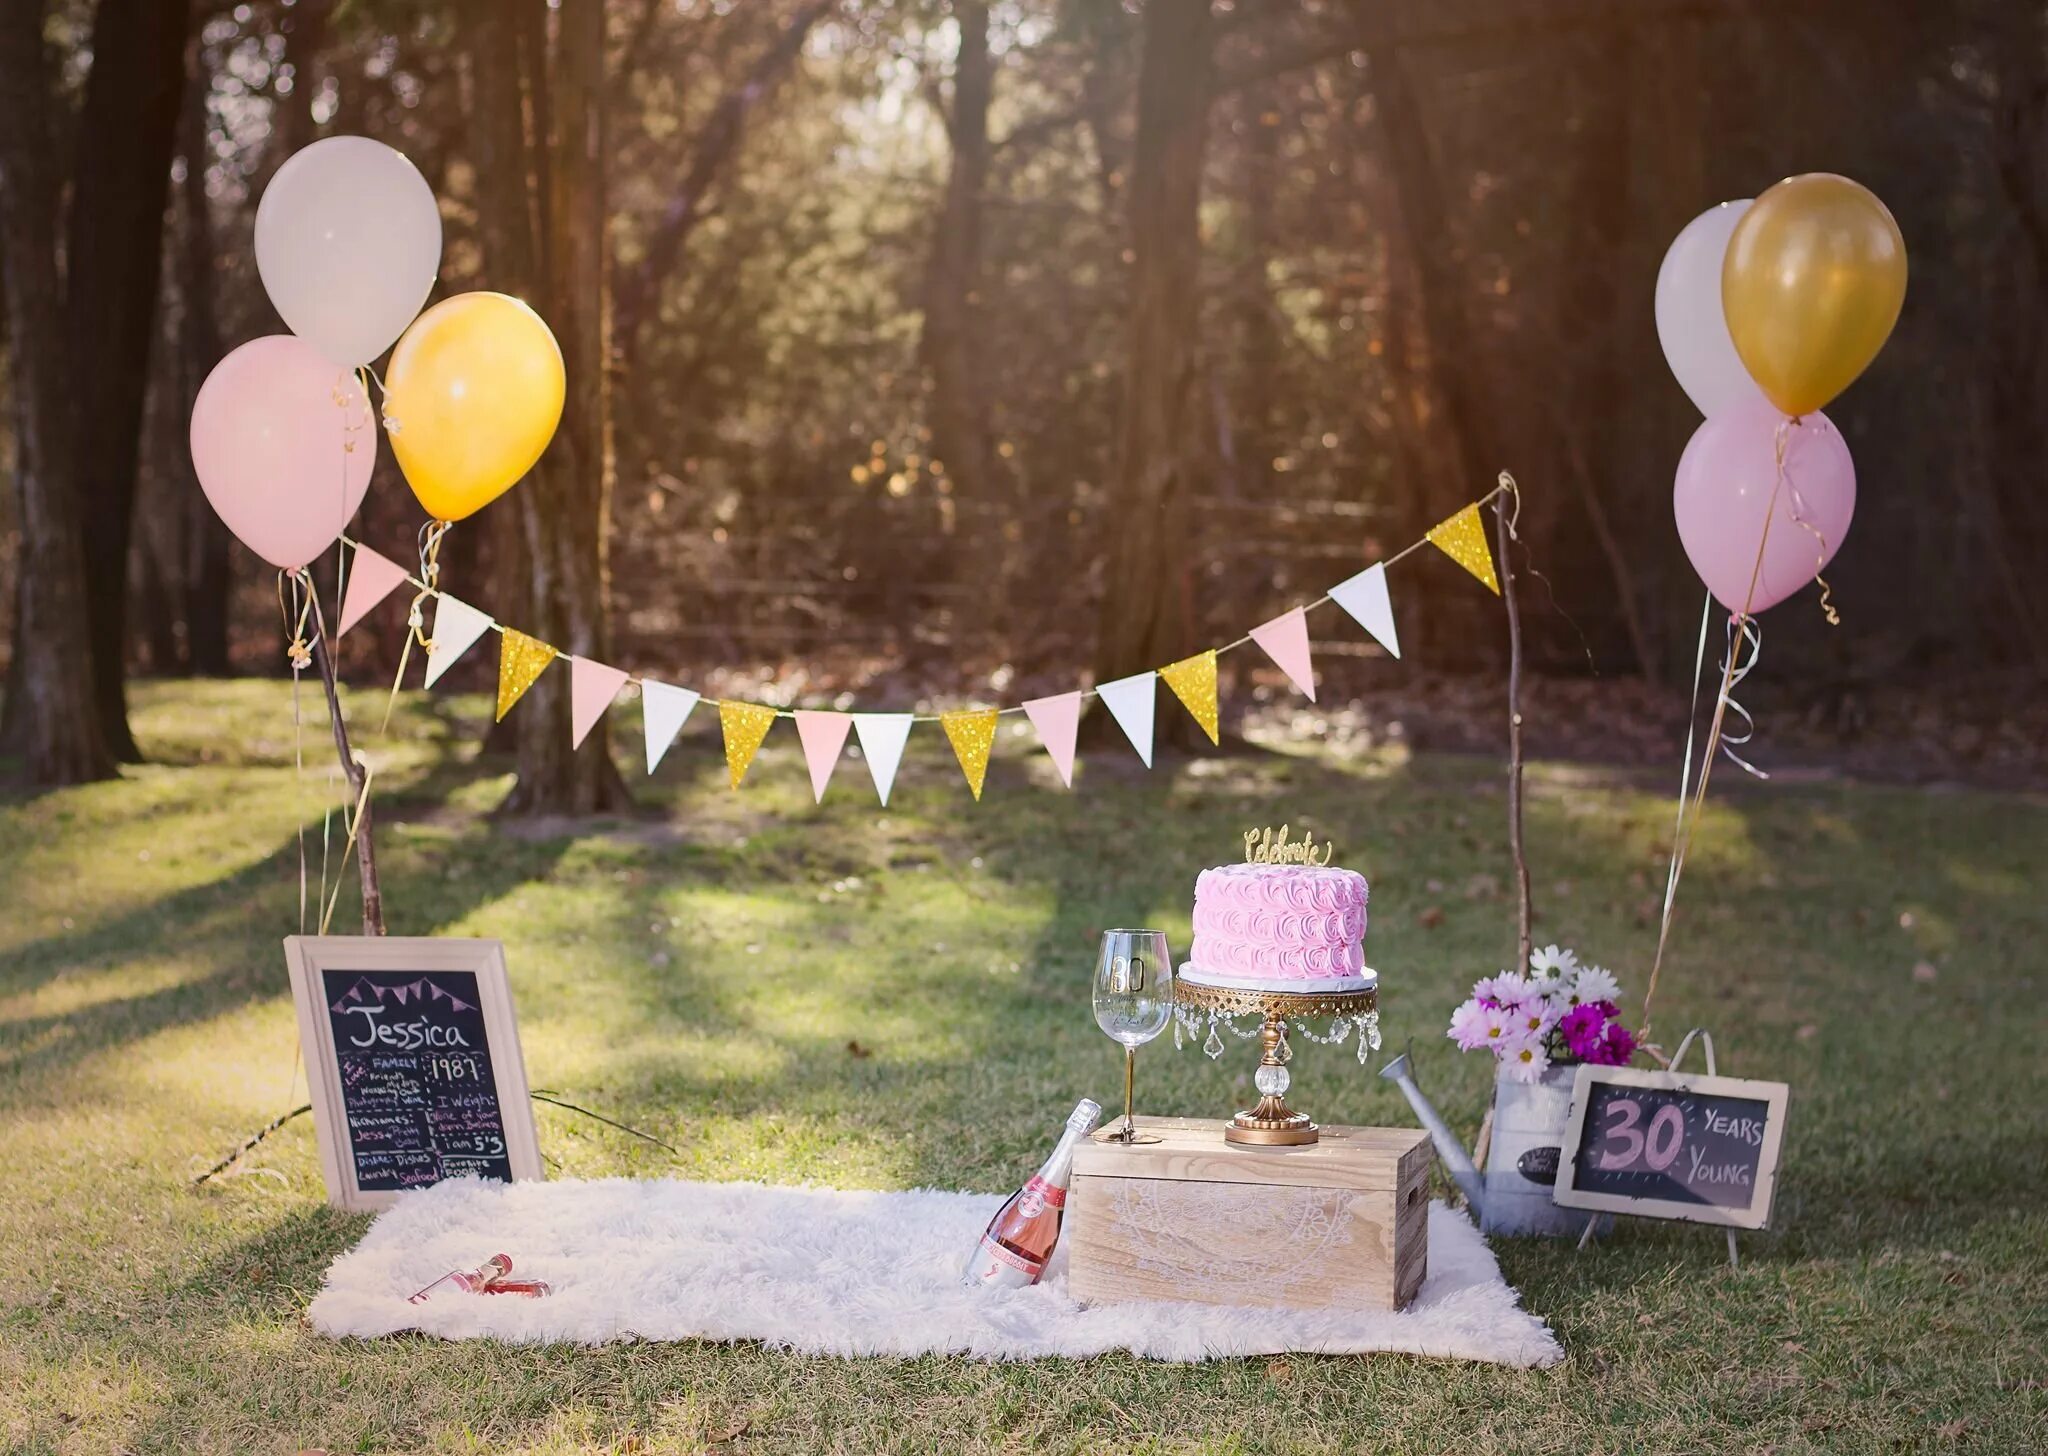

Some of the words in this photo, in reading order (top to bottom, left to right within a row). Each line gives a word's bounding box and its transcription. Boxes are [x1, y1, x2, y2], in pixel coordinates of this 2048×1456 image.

[1244, 824, 1332, 866] Celebrate
[1111, 956, 1145, 993] 30
[345, 1005, 470, 1049] Jessica
[372, 1057, 417, 1069] FAMILY
[432, 1059, 479, 1081] 1987
[437, 1096, 448, 1108] I
[450, 1092, 496, 1112] Weigh:
[461, 1110, 472, 1119] of
[476, 1110, 498, 1121] your
[452, 1140, 473, 1149] am
[1600, 1099, 1684, 1172] 30
[1704, 1108, 1762, 1146] YEARS
[395, 1154, 431, 1166] Dishes
[1688, 1144, 1749, 1187] YOUNG
[400, 1167, 438, 1185] Seafood
